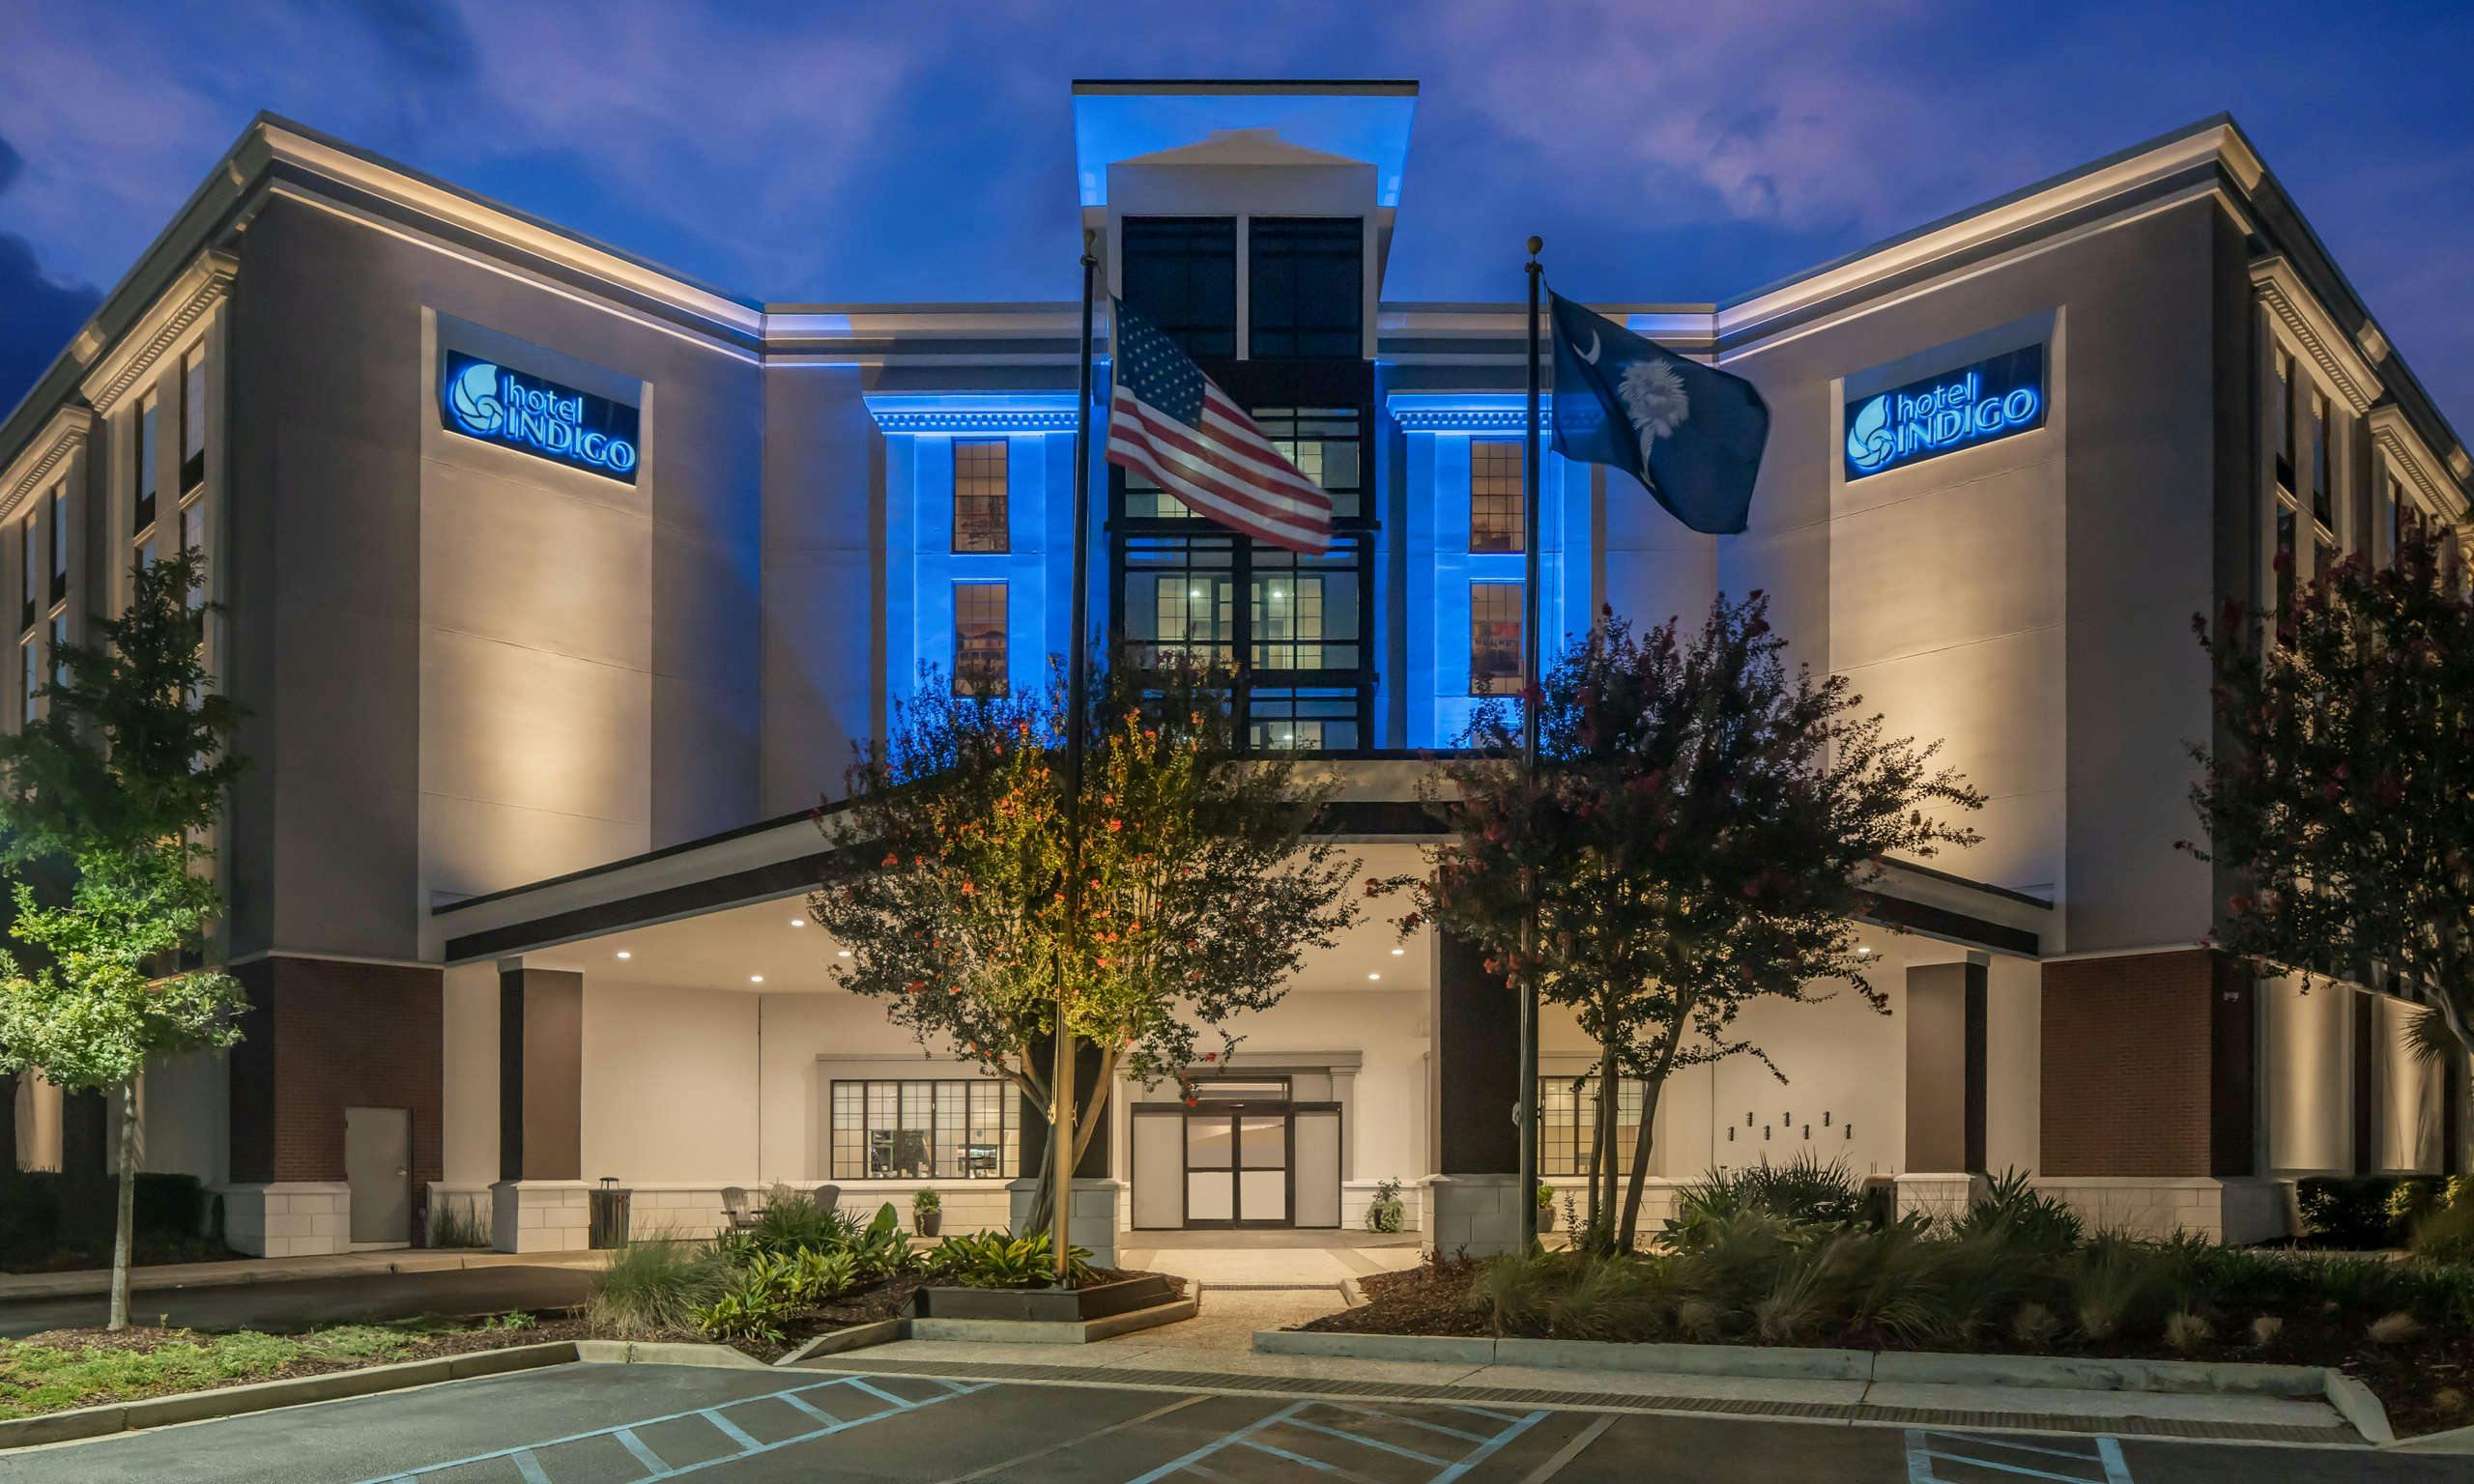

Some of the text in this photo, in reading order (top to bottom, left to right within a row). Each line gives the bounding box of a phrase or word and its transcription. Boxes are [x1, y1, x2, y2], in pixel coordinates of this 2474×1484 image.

[508, 374, 583, 424] hotel
[1897, 371, 1973, 421] hotel
[1897, 388, 2034, 453] INDIGO
[508, 406, 636, 469] INDIGO
